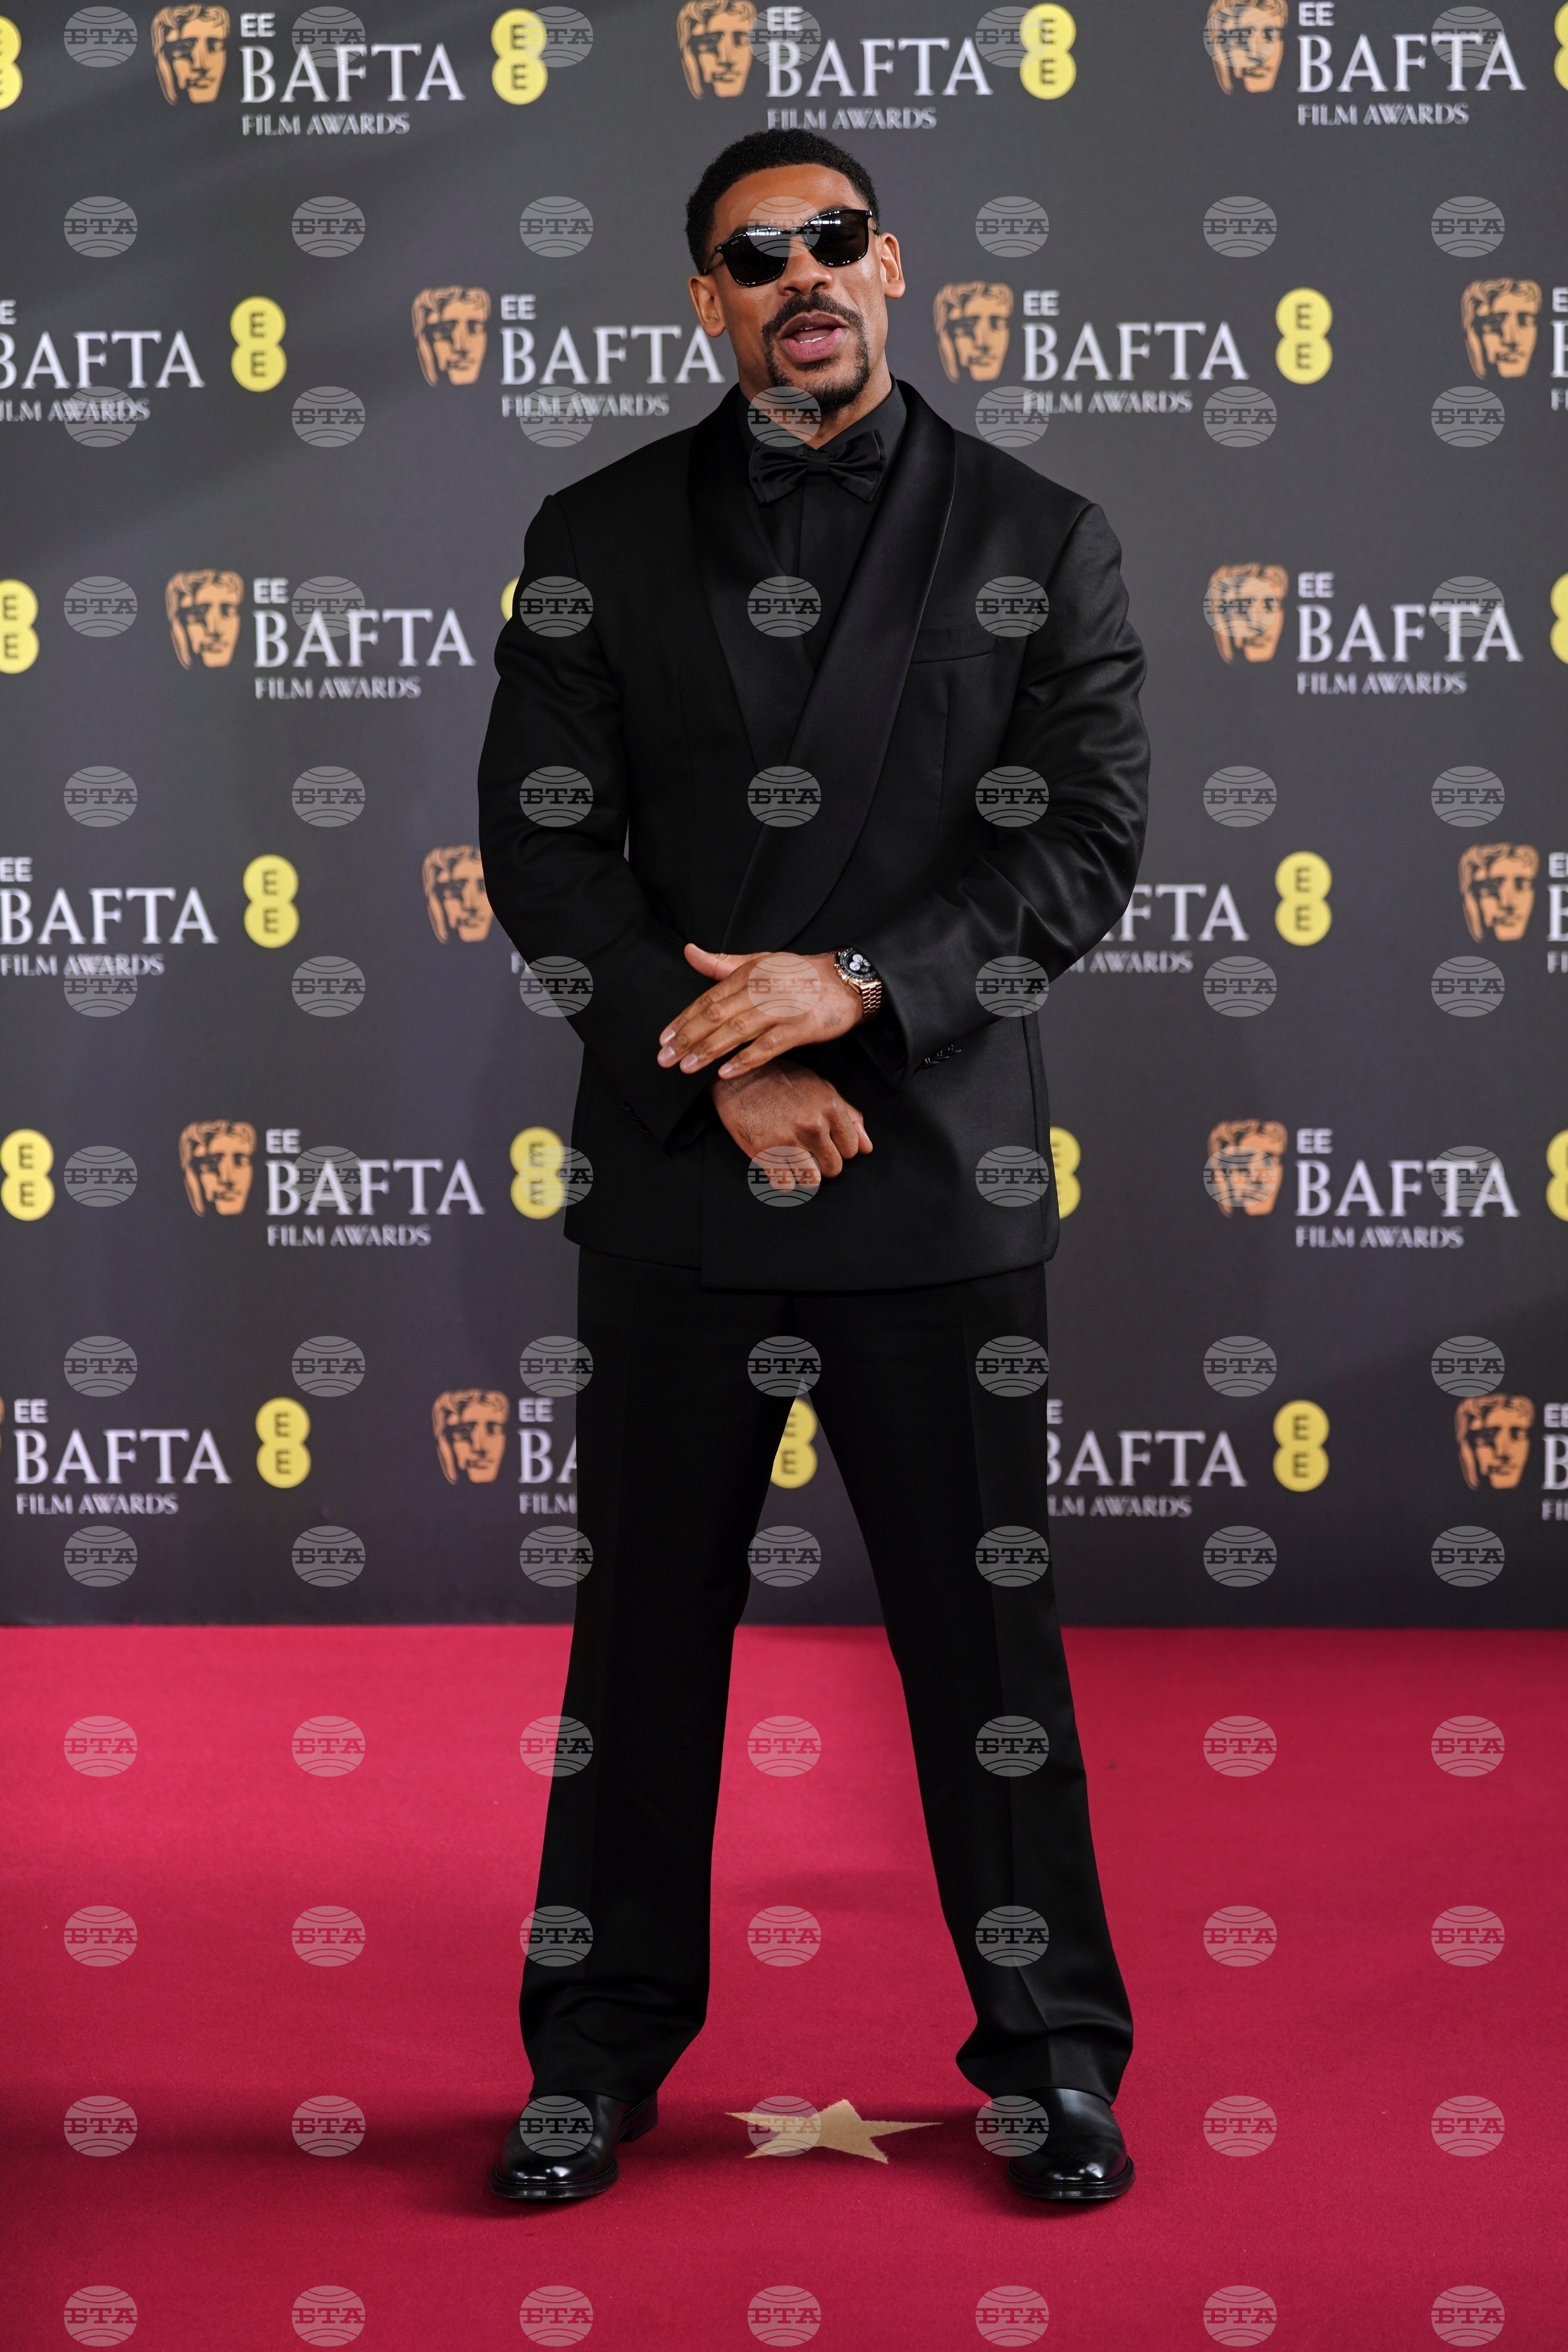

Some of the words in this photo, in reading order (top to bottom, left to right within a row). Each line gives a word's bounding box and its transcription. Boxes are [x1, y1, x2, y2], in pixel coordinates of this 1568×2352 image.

[240, 13, 275, 37] EE
[767, 6, 802, 31] EE
[1298, 1, 1334, 27] EE
[241, 44, 465, 103] BAFTA
[767, 37, 992, 97] BAFTA
[1298, 32, 1525, 92] BAFTA
[242, 115, 301, 135] FILM
[307, 113, 410, 135] AWARDS
[767, 109, 827, 130] FILM
[832, 108, 937, 129] AWARDS
[1298, 104, 1358, 125] FILM
[1364, 103, 1469, 125] AWARDS
[0, 300, 16, 325] E
[501, 294, 536, 320] EE
[1023, 290, 1058, 316] EE
[501, 325, 723, 385] BAFTA
[1024, 322, 1248, 381] BAFTA
[48, 399, 150, 422] AWARDS
[501, 396, 562, 417] FILM
[568, 394, 669, 417] AWARDS
[1022, 392, 1082, 413] FILM
[1088, 391, 1193, 413] AWARDS
[253, 578, 288, 604] EE
[1298, 572, 1333, 598] EE
[254, 608, 474, 667] BAFTA
[1298, 603, 1522, 662] BAFTA
[254, 677, 313, 699] FILM
[319, 677, 422, 699] AWARDS
[1297, 672, 1357, 695] FILM
[1362, 672, 1467, 694] AWARDS
[0, 857, 32, 882] EE
[0, 888, 216, 945] BAFTA
[1101, 883, 1249, 941] FTA
[0, 955, 58, 976] FILM
[64, 954, 164, 977] AWARDS
[1091, 951, 1193, 973] AWARDS
[266, 1129, 300, 1154] EE
[1296, 1128, 1332, 1154] EE
[267, 1158, 483, 1216] BAFTA
[1297, 1159, 1519, 1217] BAFTA
[267, 1225, 325, 1247] FILM
[330, 1225, 431, 1246] AWARDS
[1295, 1226, 1355, 1247] FILM
[1361, 1226, 1464, 1248] AWARDS
[14, 1399, 47, 1423] EE
[518, 1398, 553, 1423] EE
[1047, 1399, 1062, 1424] E
[15, 1429, 230, 1484] BAFTA
[16, 1494, 73, 1514] FILM
[78, 1494, 178, 1514] AWARDS
[519, 1493, 577, 1514] FILM
[1048, 1495, 1085, 1516] LM
[1091, 1496, 1192, 1517] AWARDS
